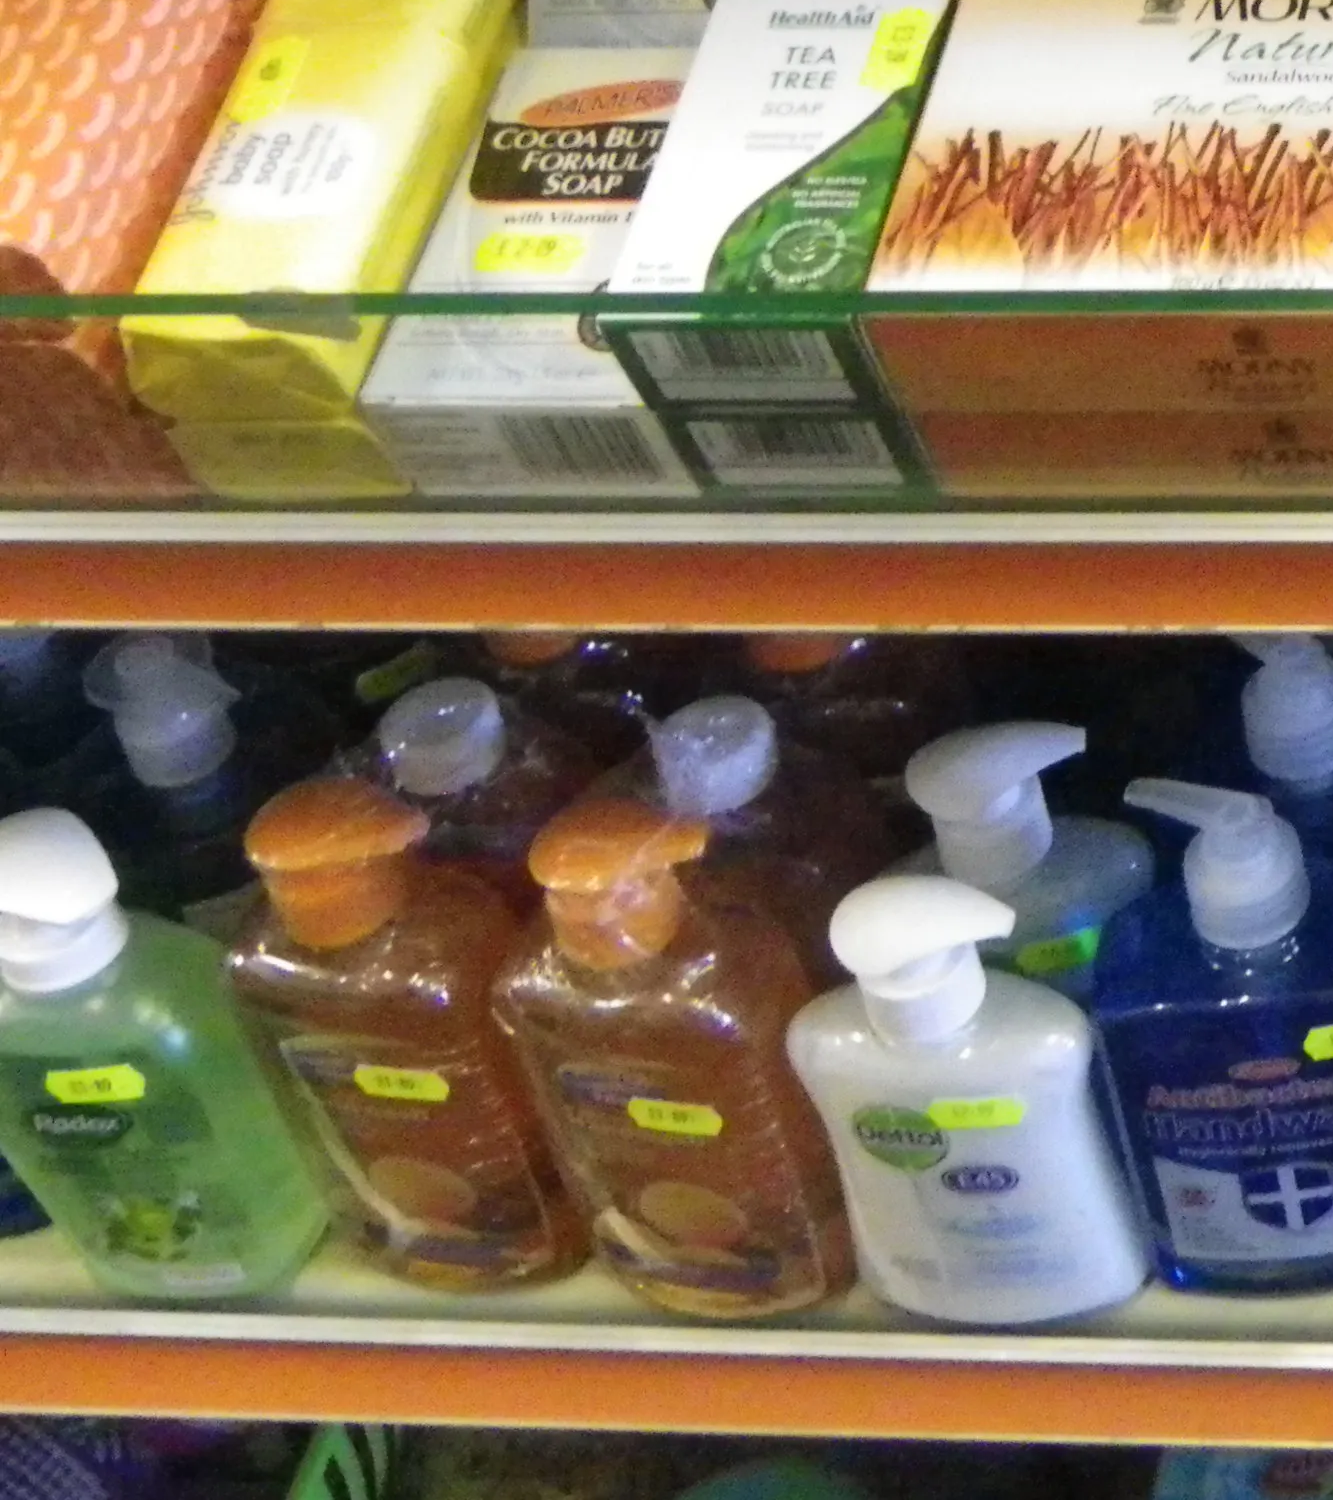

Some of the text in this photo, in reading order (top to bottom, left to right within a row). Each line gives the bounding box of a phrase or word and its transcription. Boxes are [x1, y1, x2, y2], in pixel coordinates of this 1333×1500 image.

[769, 10, 875, 29] HealthAid
[785, 46, 837, 65] TEA
[770, 71, 837, 90] TREE
[761, 102, 825, 118] SOAP
[1153, 93, 1213, 118] Fine
[1224, 93, 1333, 120] English
[492, 127, 666, 152] COCOA BUT
[543, 173, 623, 198] SOAP
[504, 210, 618, 226] with Vitamin
